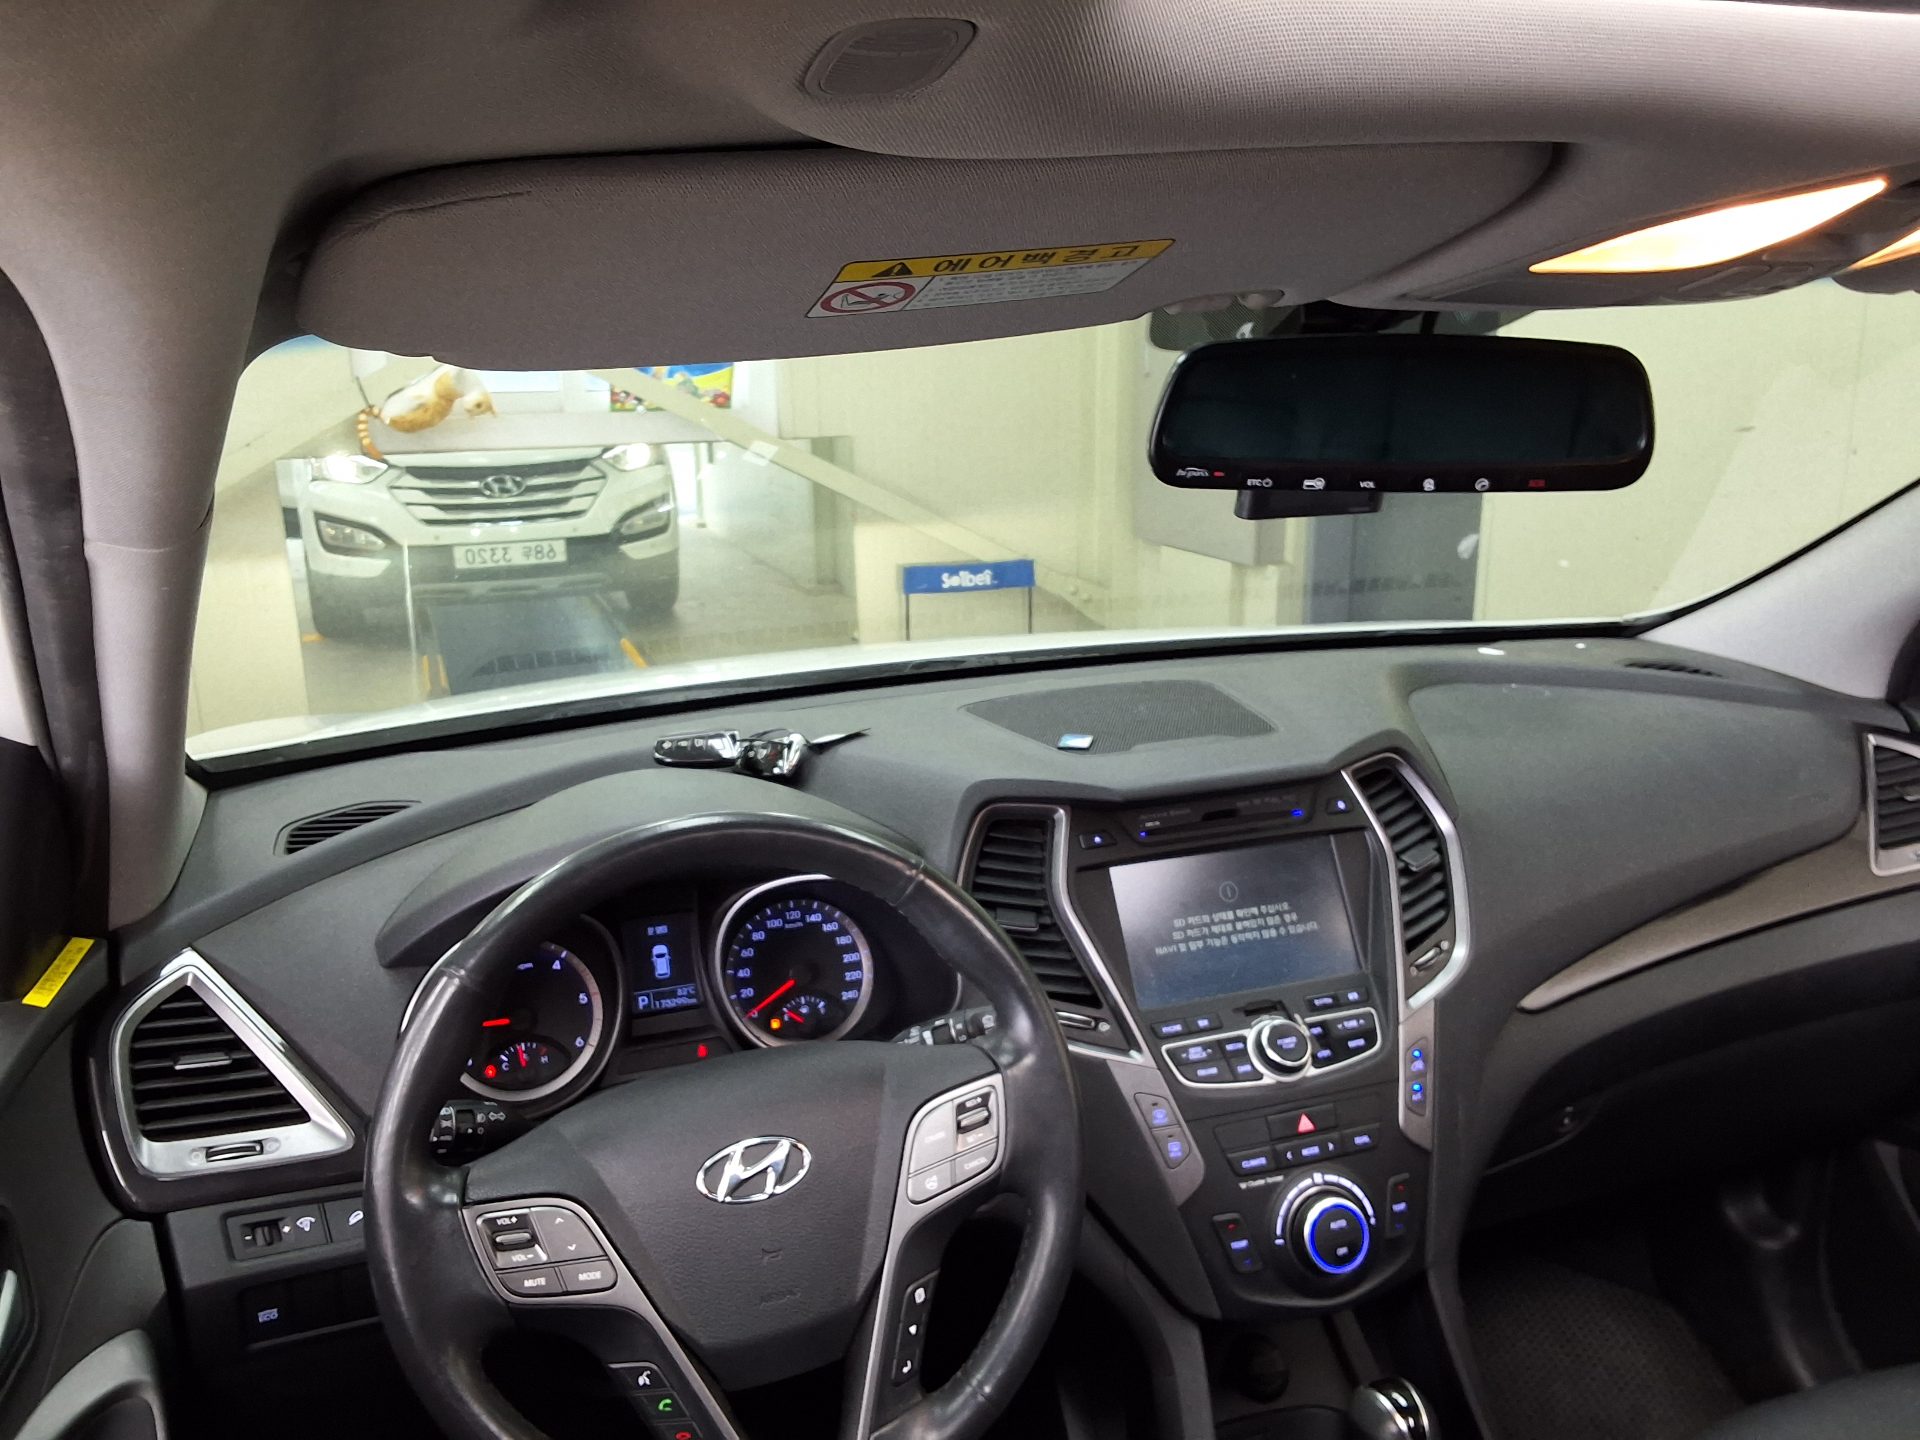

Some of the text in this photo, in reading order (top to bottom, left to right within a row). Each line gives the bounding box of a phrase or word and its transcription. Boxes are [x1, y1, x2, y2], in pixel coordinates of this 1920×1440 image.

[1247, 478, 1263, 486] ETC
[1359, 481, 1376, 489] VOL
[786, 910, 801, 919] 120
[805, 913, 822, 922] 140
[766, 918, 783, 928] 100
[822, 922, 839, 931] 160
[752, 931, 765, 940] 80
[836, 935, 852, 945] 180
[741, 948, 754, 957] 60
[843, 952, 860, 962] 200
[551, 960, 561, 970] 4
[737, 967, 751, 977] 40
[845, 971, 862, 981] 220
[740, 988, 753, 998] 20
[842, 990, 859, 1000] 240
[578, 993, 588, 1004] 5
[638, 996, 648, 1009] P
[575, 1037, 585, 1047] 6
[540, 1056, 549, 1064] H
[502, 1062, 509, 1071] C
[578, 1271, 602, 1281] MODE
[523, 1277, 546, 1287] MUTE
